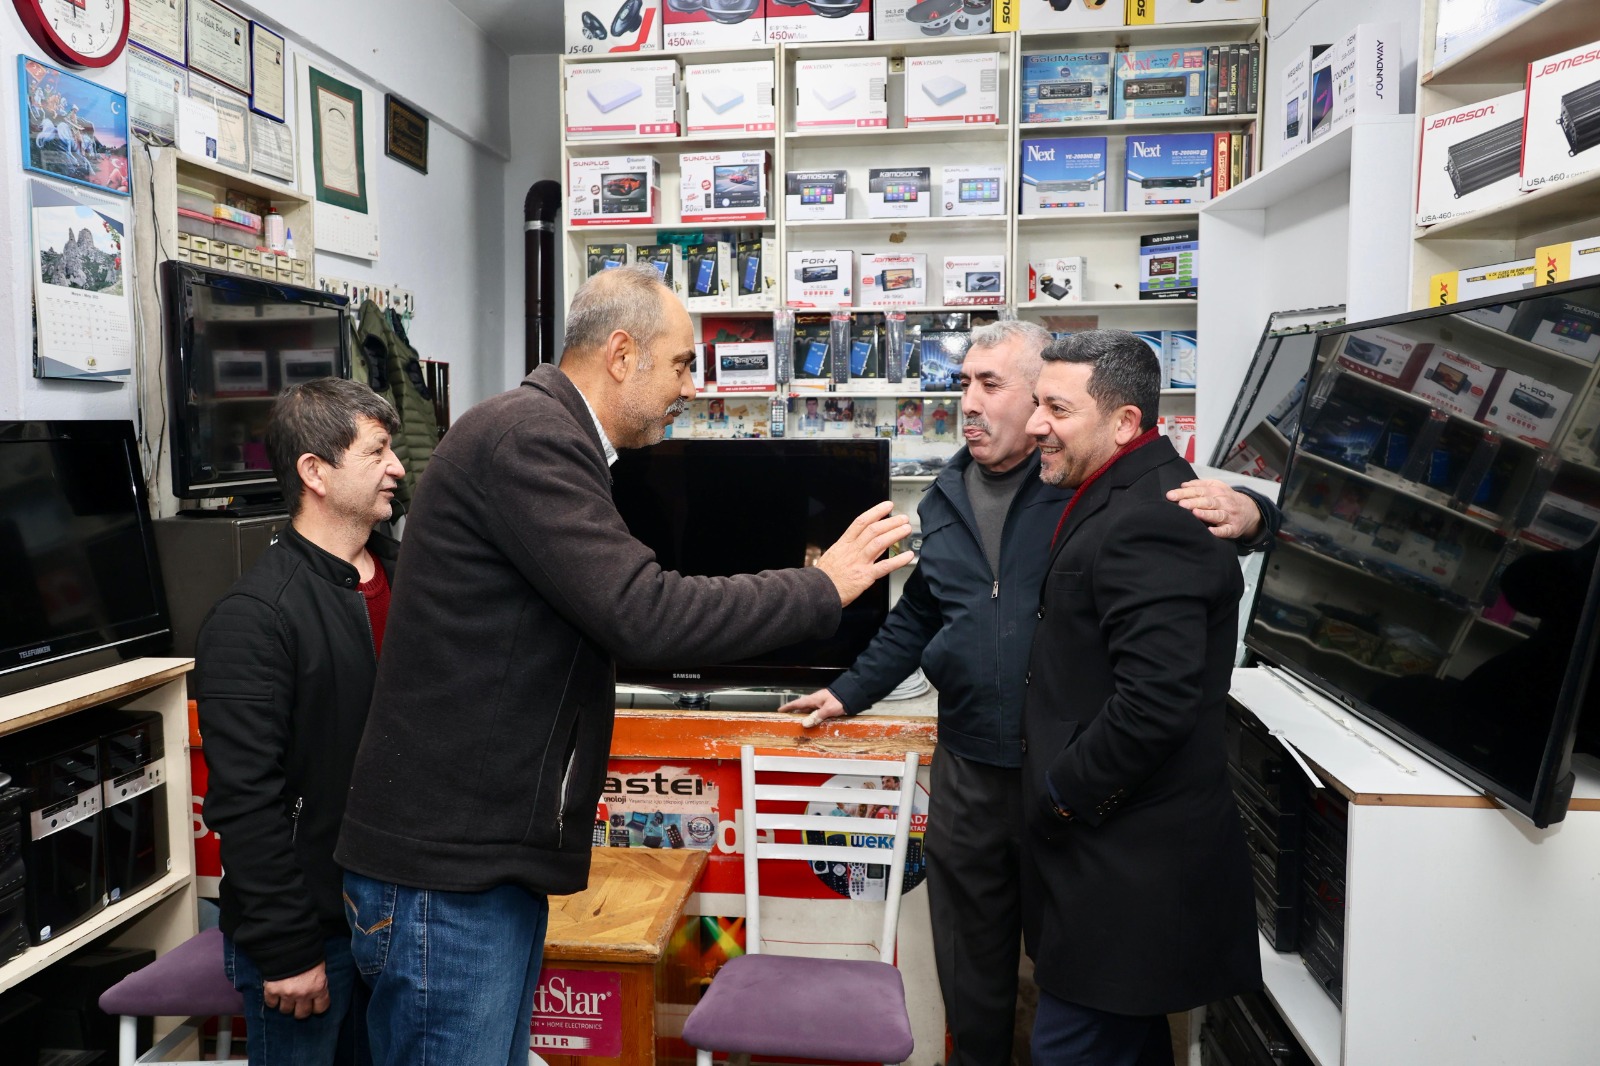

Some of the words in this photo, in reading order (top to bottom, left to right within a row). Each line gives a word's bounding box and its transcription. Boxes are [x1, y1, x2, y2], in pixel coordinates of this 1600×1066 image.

[569, 45, 593, 54] JS-60
[1030, 54, 1102, 62] GoldMaster
[1122, 54, 1152, 71] Next
[1426, 105, 1495, 130] Jameson
[1027, 146, 1055, 161] Next
[1133, 142, 1161, 158] Next
[1526, 172, 1565, 187] USA-460
[1422, 212, 1452, 223] USA-460
[19, 646, 51, 659] TELEFUNKEN
